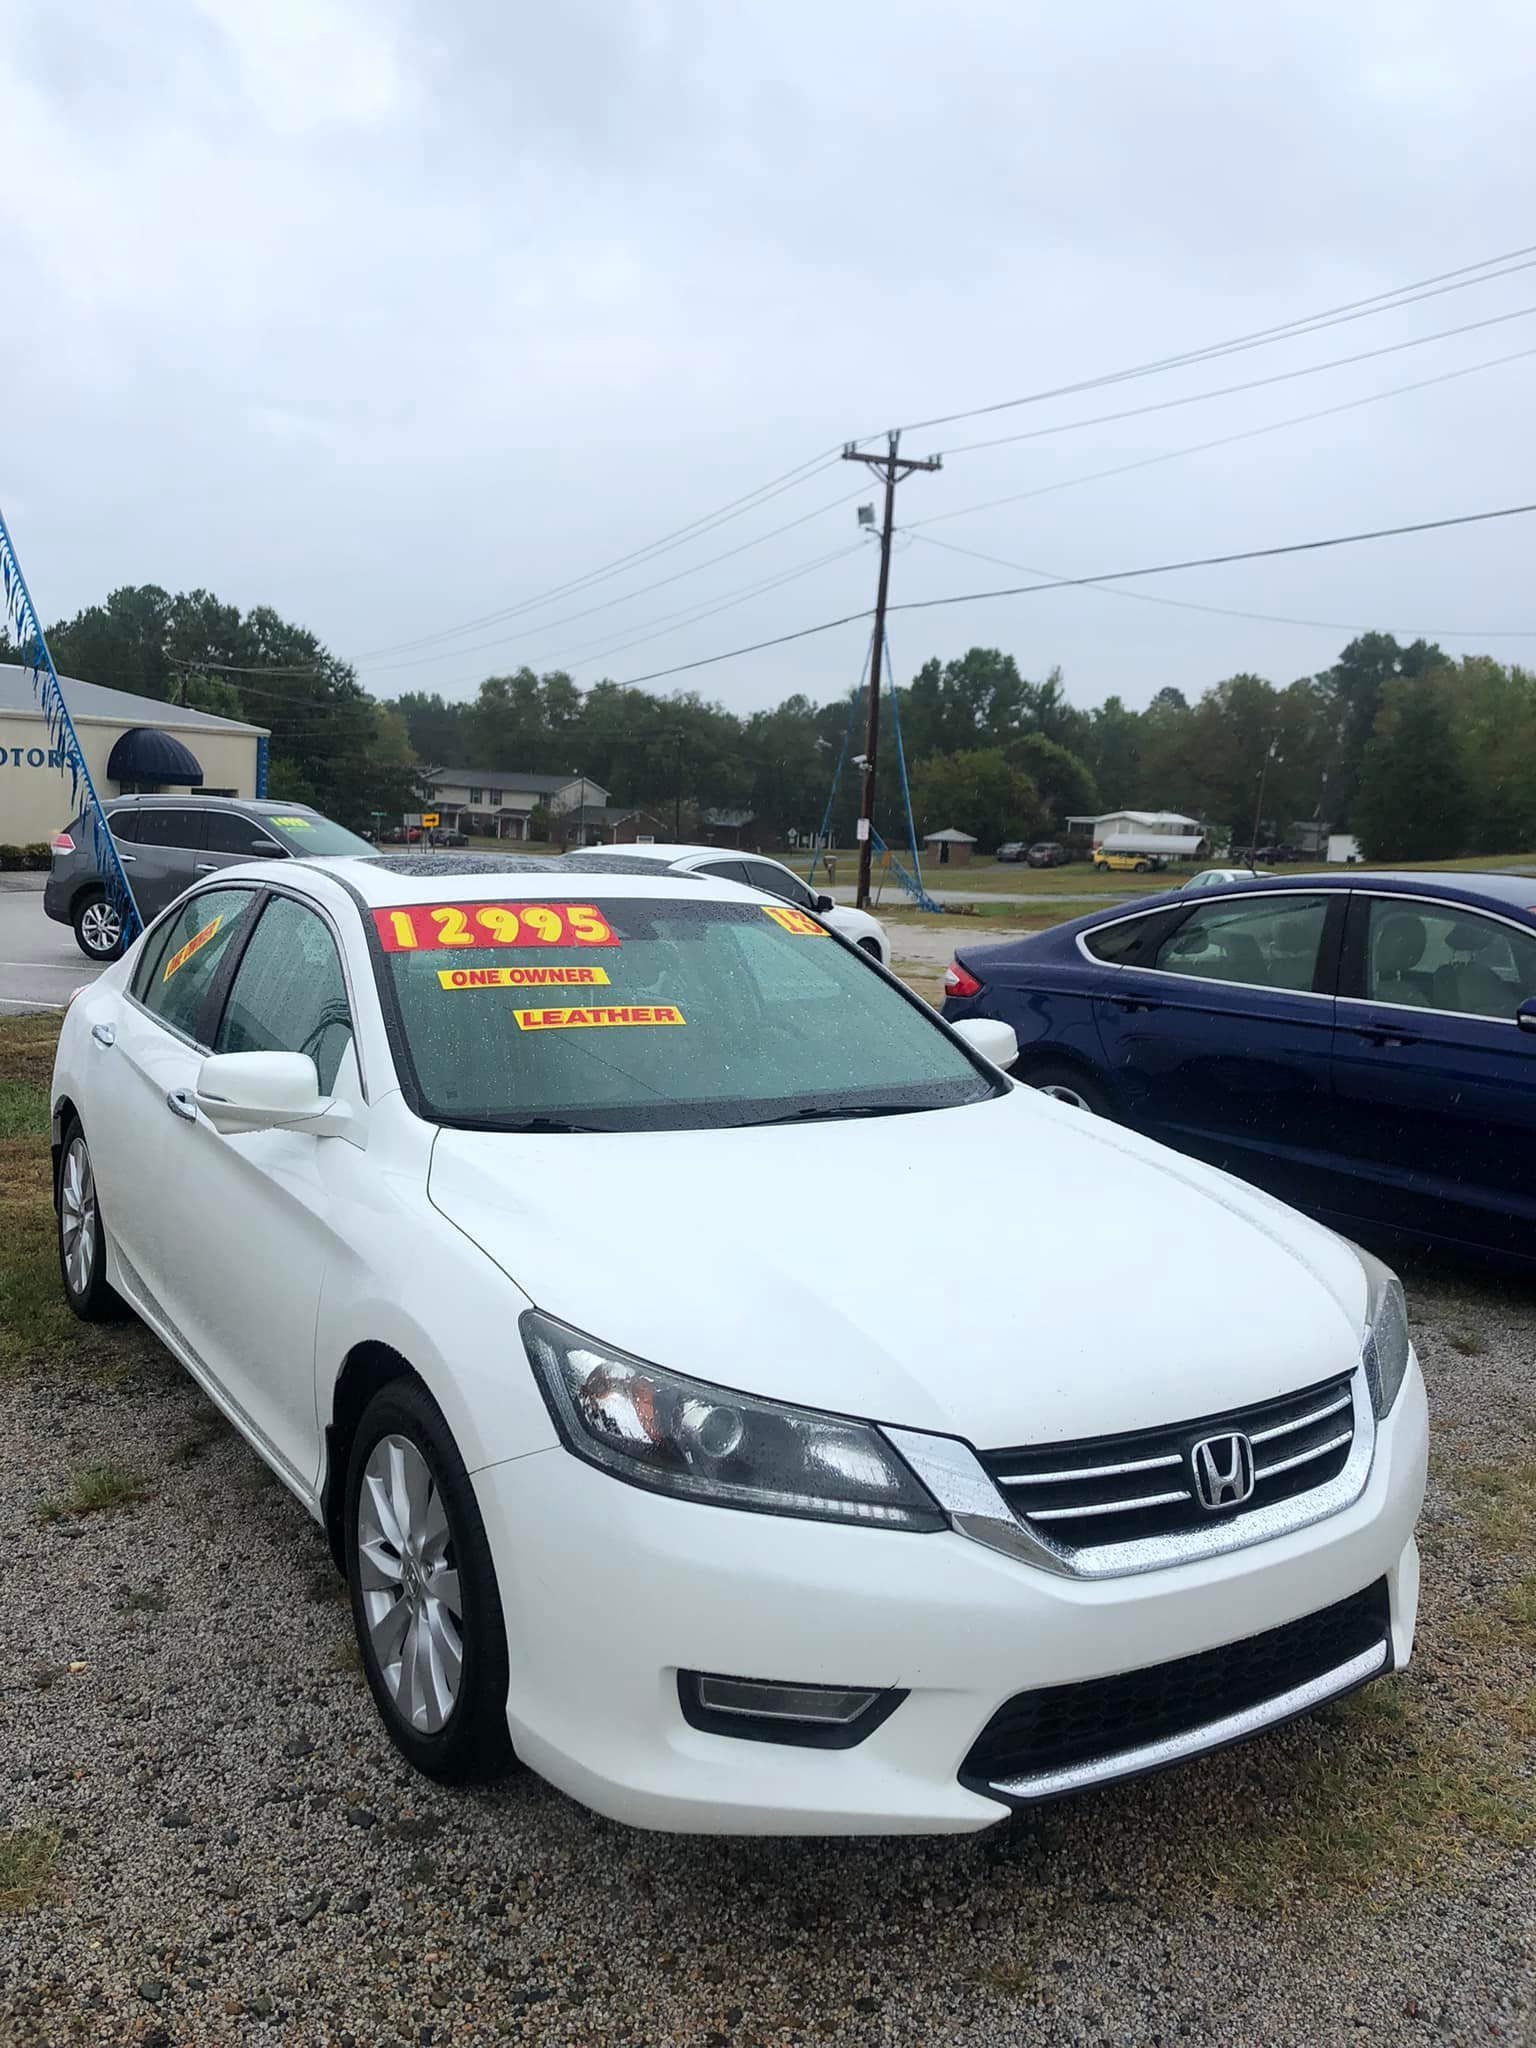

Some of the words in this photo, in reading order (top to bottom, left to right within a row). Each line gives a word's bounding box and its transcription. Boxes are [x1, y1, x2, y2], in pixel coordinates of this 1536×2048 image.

[390, 907, 609, 948] 12995
[451, 970, 501, 986] ONE
[509, 969, 594, 983] OWNER
[522, 1008, 675, 1027] LEATHER
